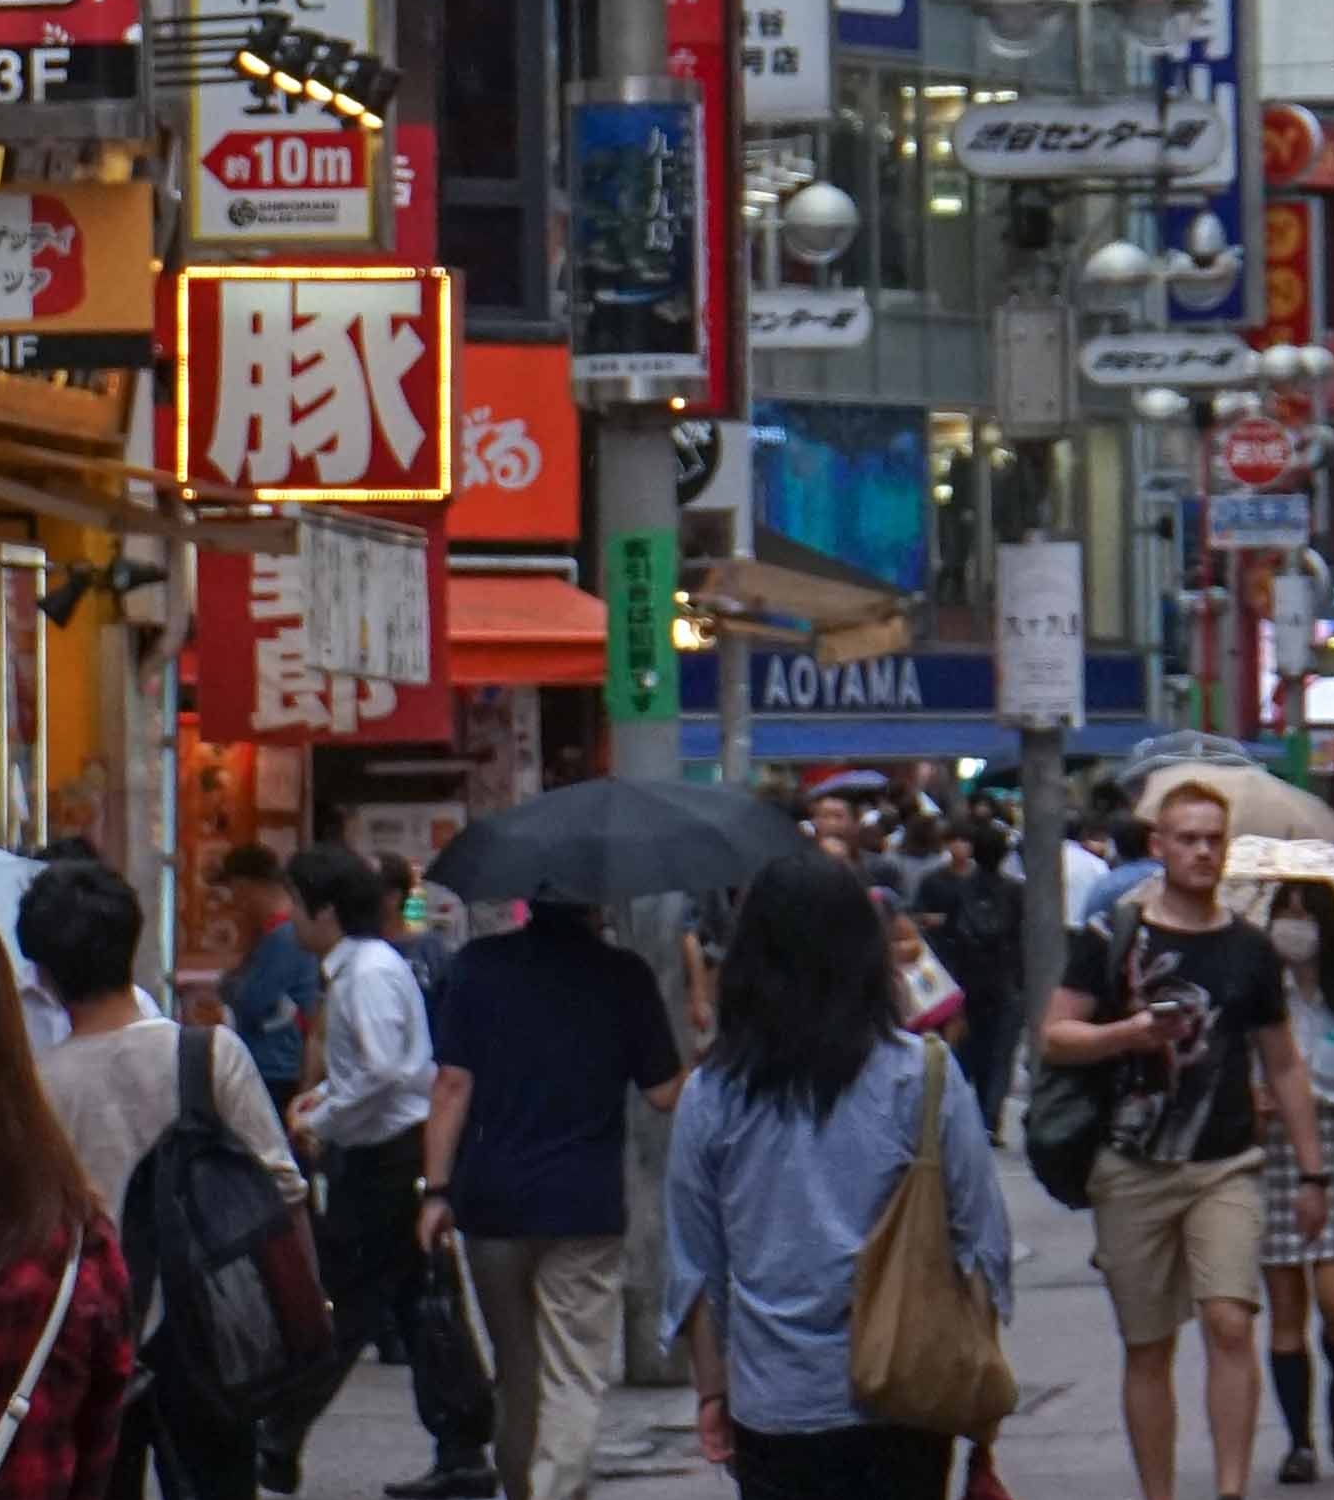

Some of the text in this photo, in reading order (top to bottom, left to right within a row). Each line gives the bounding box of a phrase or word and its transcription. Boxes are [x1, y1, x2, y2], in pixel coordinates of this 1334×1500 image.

[965, 118, 1207, 152] 渋谷センター街
[207, 280, 429, 486] 豚
[765, 652, 923, 708] AOYAMA
